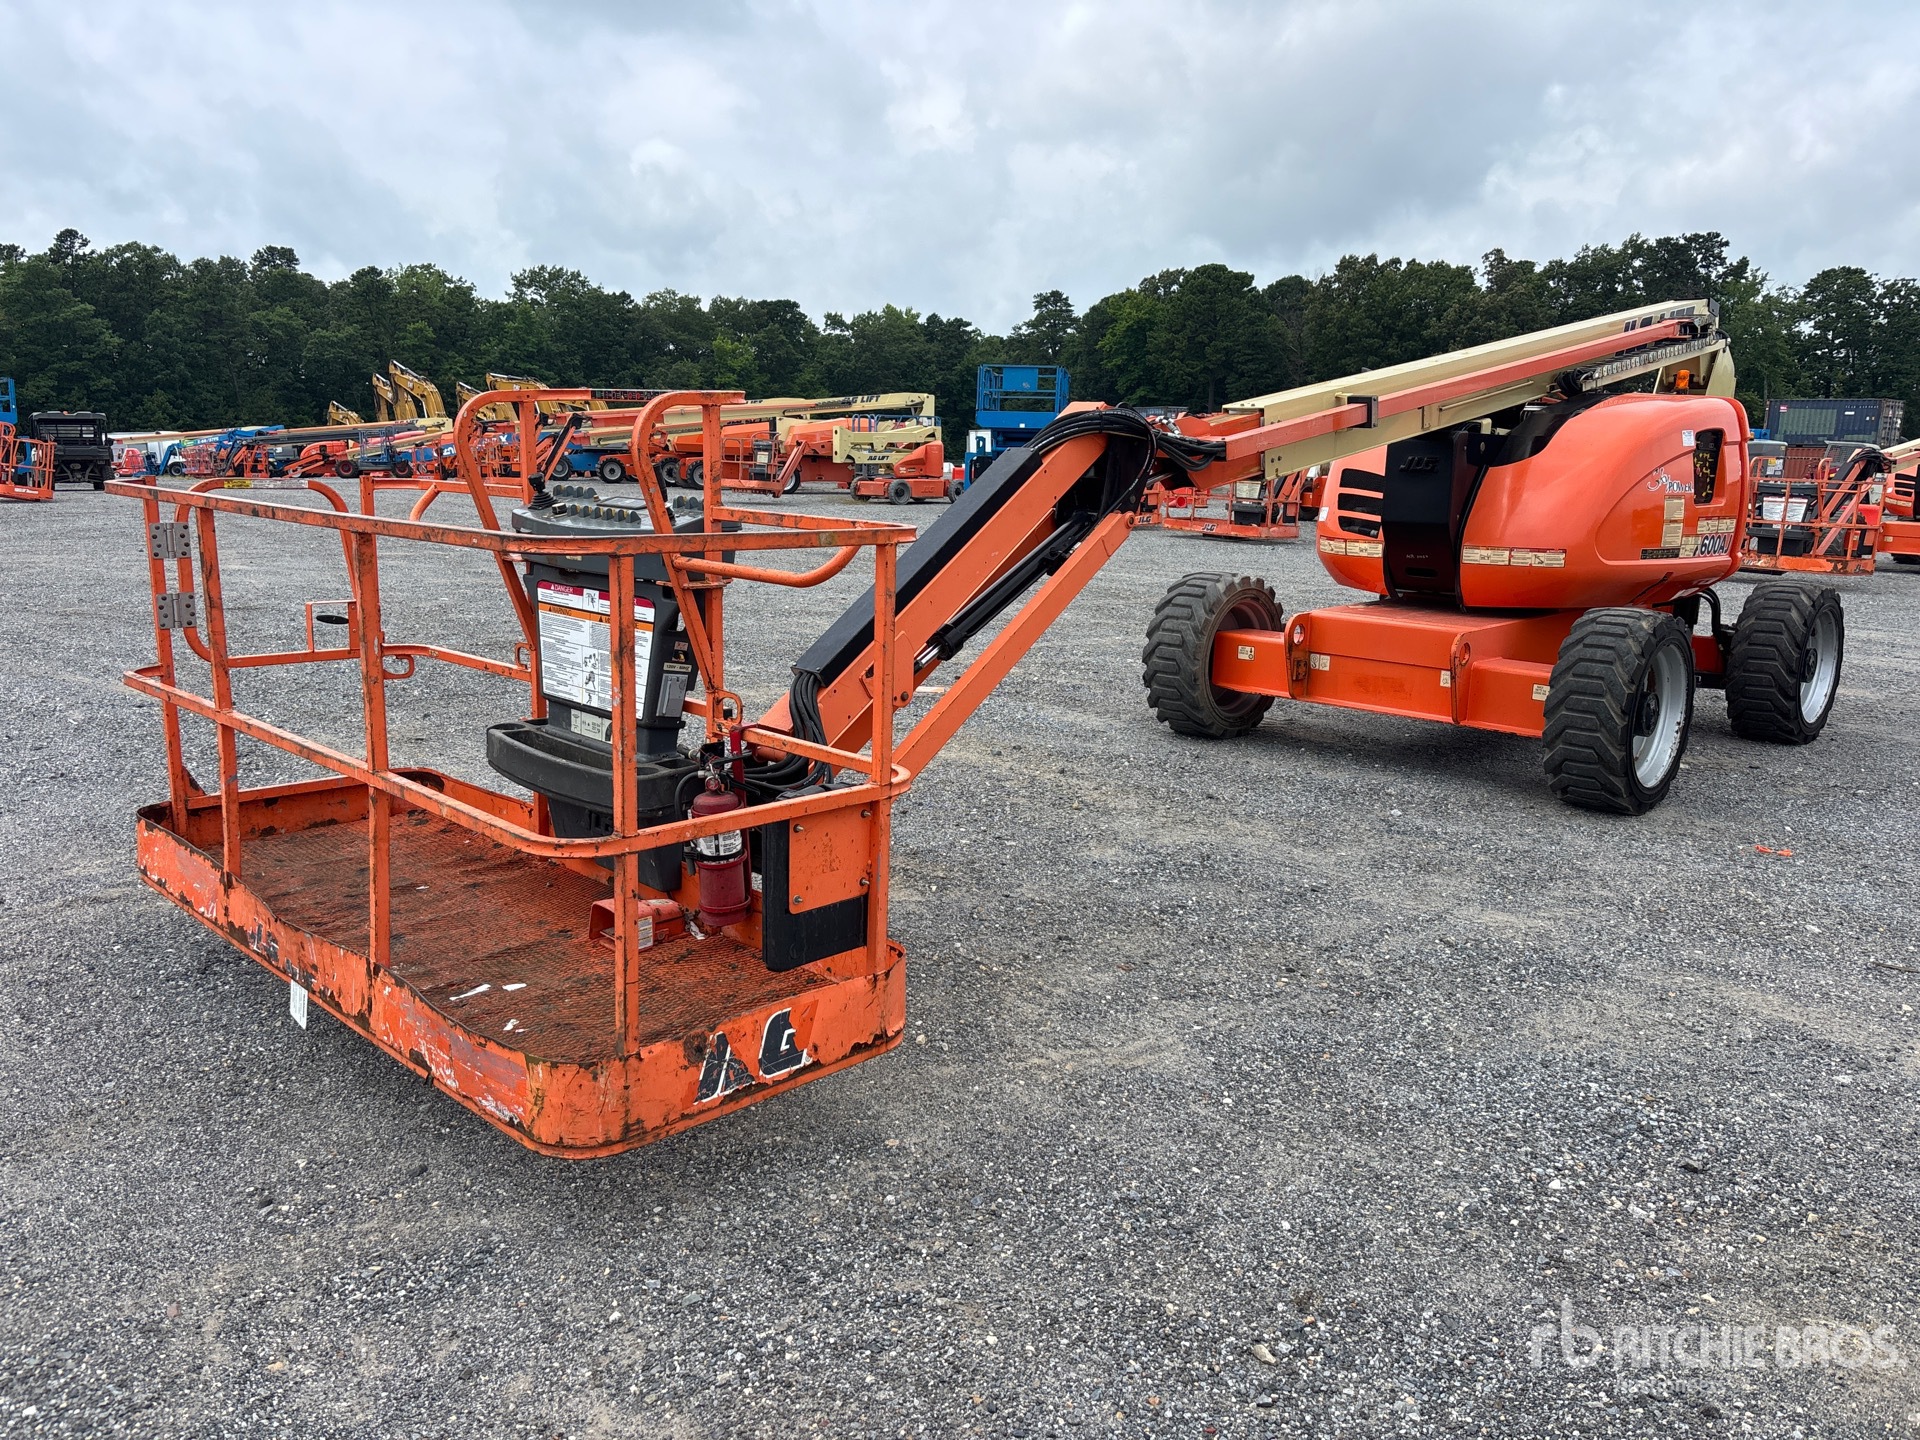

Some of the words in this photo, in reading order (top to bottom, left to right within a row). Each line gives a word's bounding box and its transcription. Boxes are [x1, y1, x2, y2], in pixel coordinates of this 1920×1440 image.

[860, 394, 881, 403] LIFT
[1400, 455, 1440, 473] JLG
[1137, 515, 1152, 523] JLG
[1202, 524, 1216, 532] JLG
[1700, 533, 1733, 556] 600AJ
[554, 584, 574, 594] DANGER
[552, 605, 572, 616] WARNING
